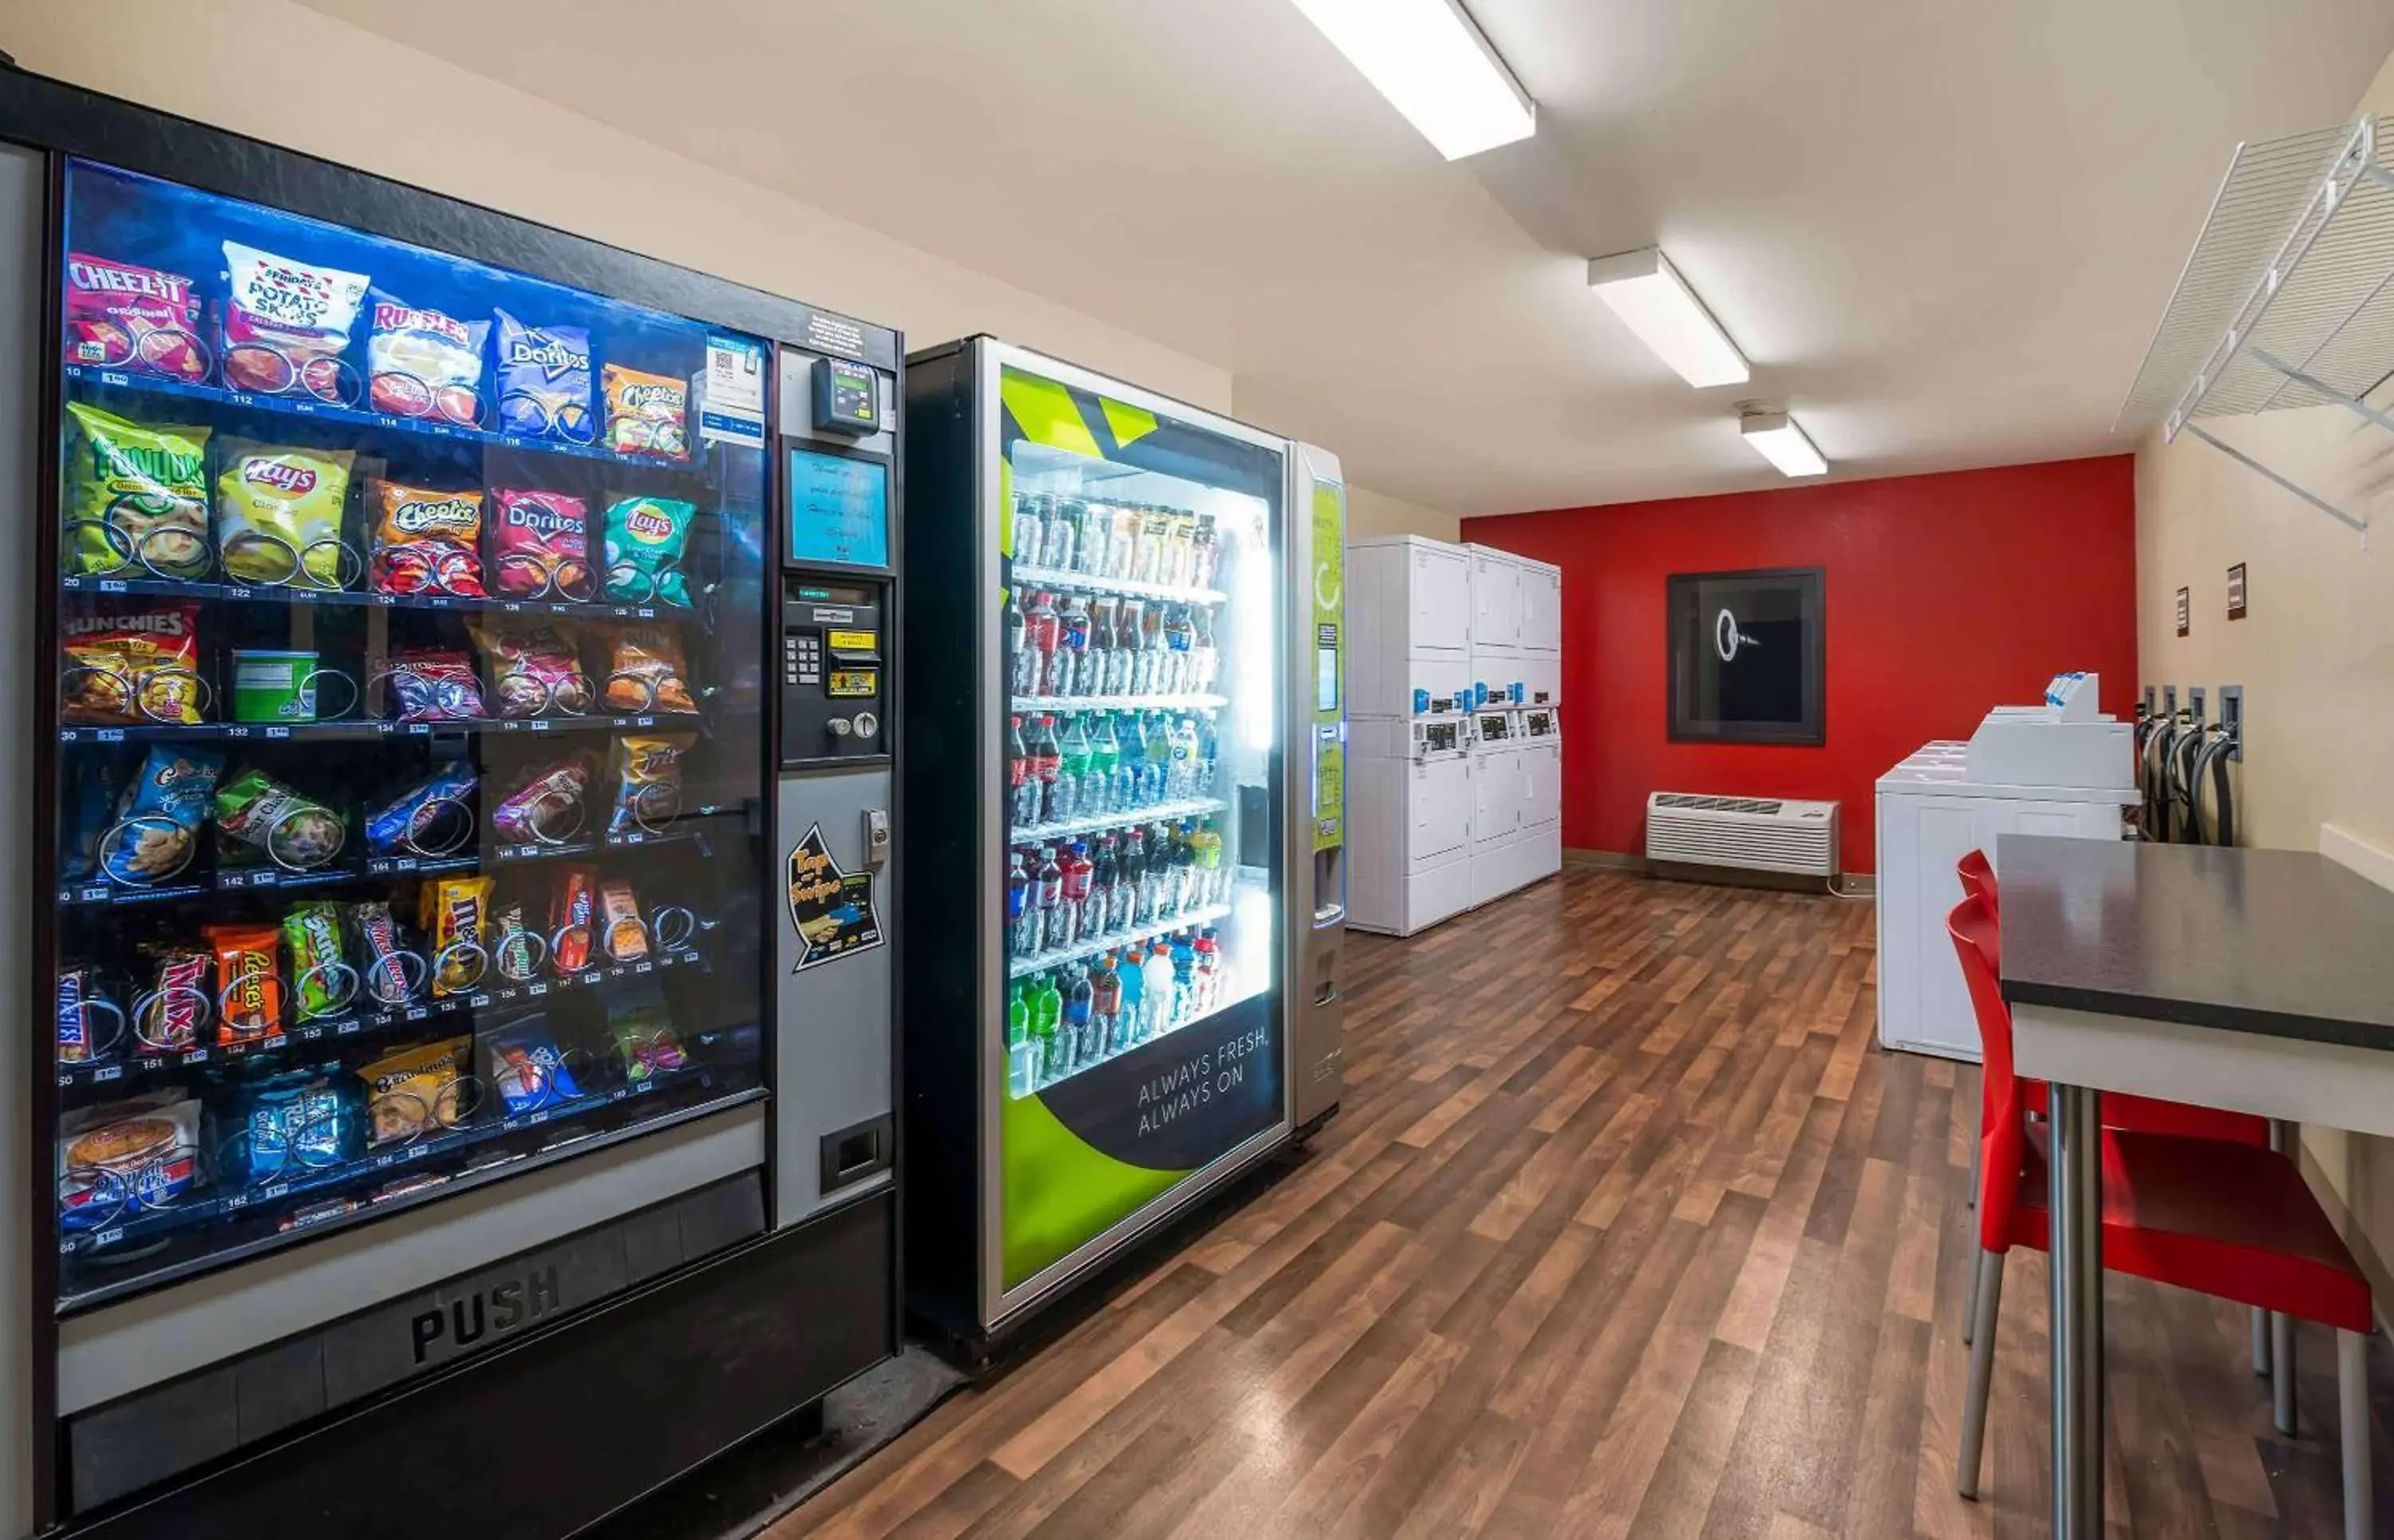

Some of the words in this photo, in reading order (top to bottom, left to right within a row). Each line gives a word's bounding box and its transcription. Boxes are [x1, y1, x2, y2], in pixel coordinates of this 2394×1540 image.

[70, 263, 180, 302] CHEEZ-IT
[512, 342, 589, 371] Doritos
[508, 506, 584, 535] Doritos
[65, 578, 80, 587] 20
[231, 588, 251, 598] 122
[61, 732, 77, 741] 30
[230, 728, 248, 736] 132
[143, 1059, 162, 1070] 151
[1137, 1054, 1211, 1108] ALWAYS
[1218, 1026, 1269, 1068] FRESH.
[1137, 1081, 1211, 1138] ALWAYS
[1217, 1063, 1243, 1093] ON
[412, 1265, 559, 1364] PUSH
